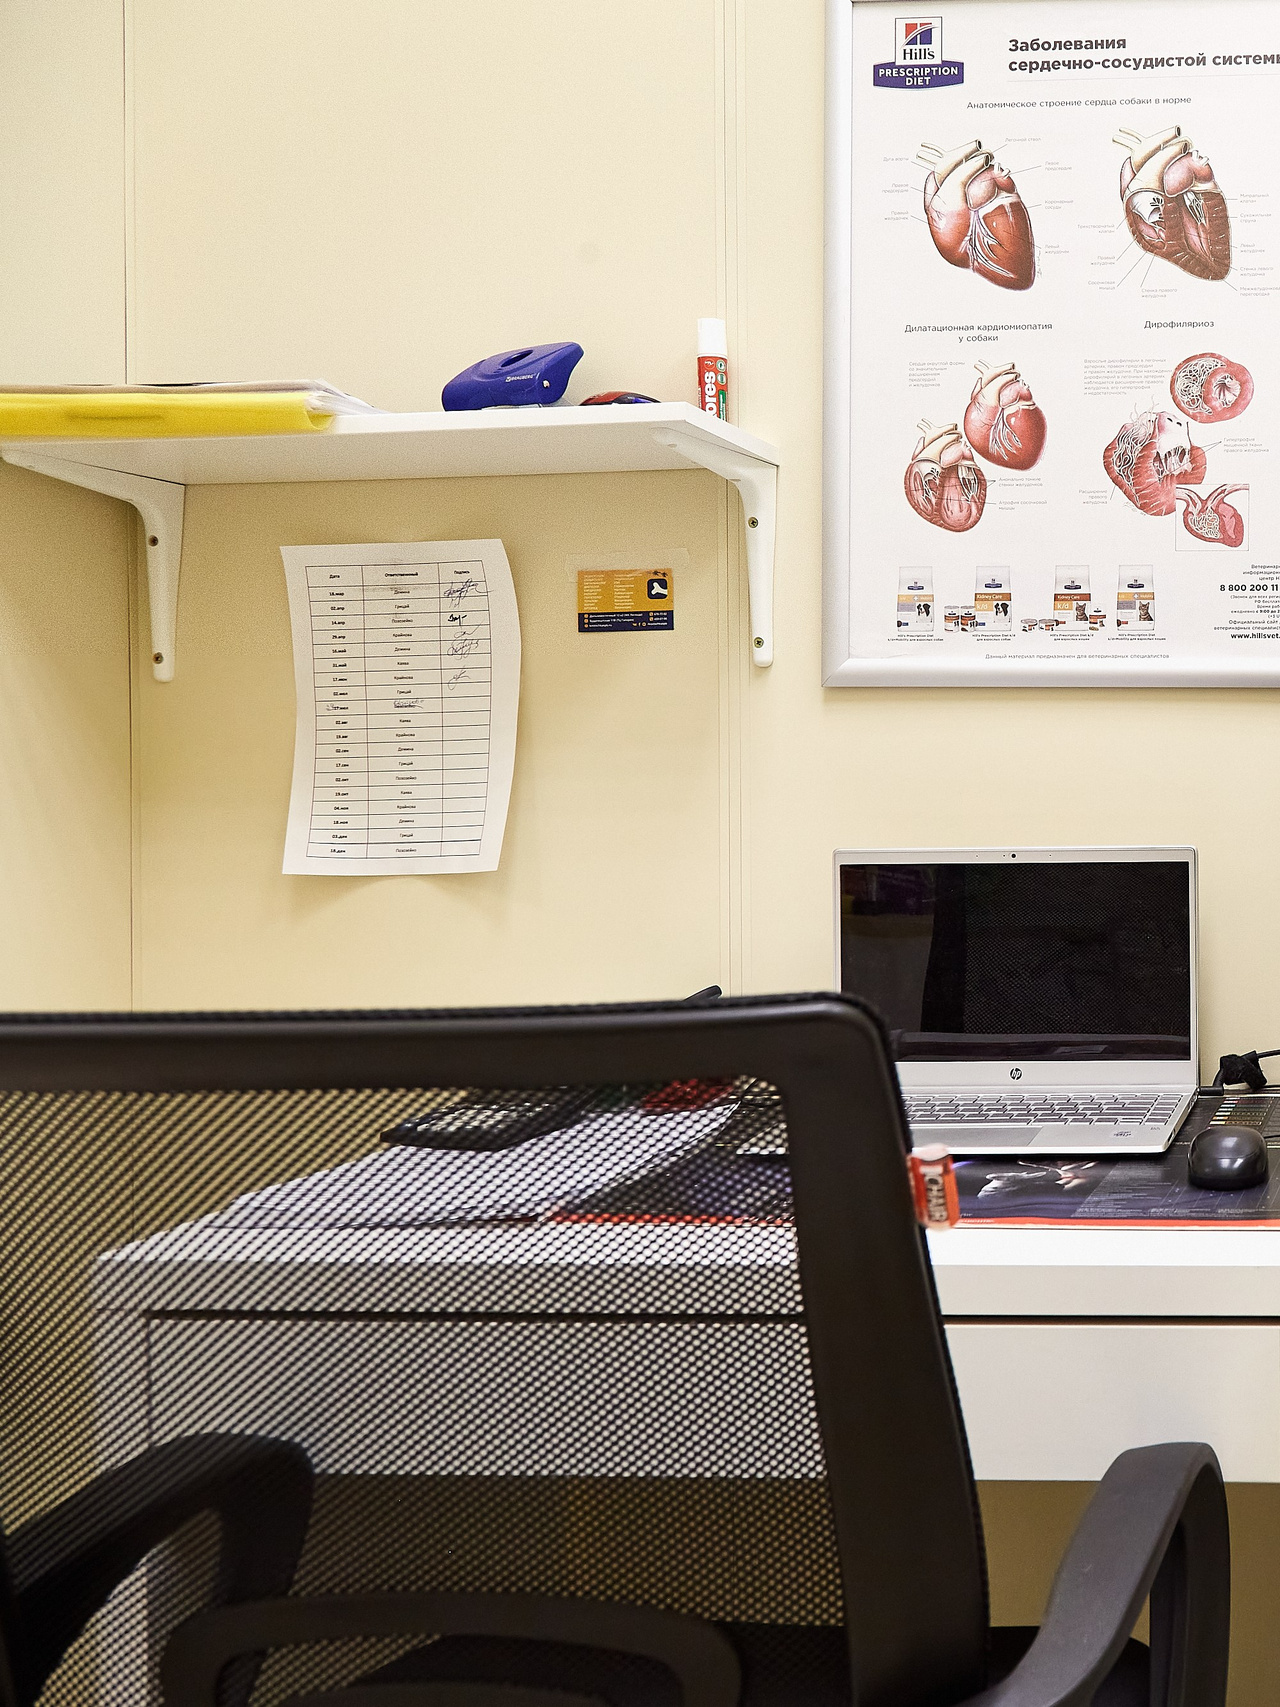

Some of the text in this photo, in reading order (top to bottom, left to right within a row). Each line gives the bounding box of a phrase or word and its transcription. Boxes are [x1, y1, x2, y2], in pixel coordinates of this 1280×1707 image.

[1008, 38, 1127, 52] Заболевания
[903, 48, 935, 61] Hill's
[1008, 53, 1207, 73] сердечно-сосудистой
[878, 66, 958, 77] PRESCRIPTION
[905, 77, 931, 86] DIET
[966, 100, 1037, 109] Анатомическое
[1039, 100, 1082, 109] строение
[1085, 98, 1117, 107] сердца
[1119, 97, 1153, 106] собаки
[1163, 97, 1192, 106] норме
[904, 323, 1053, 333] Дилатационная кардиомиопатия
[1144, 320, 1215, 329] Дирофиляриоз
[966, 334, 999, 342] собаки
[703, 370, 717, 418] ores
[1219, 584, 1226, 592] 8
[1228, 584, 1247, 592] 800
[1249, 584, 1269, 592] 200
